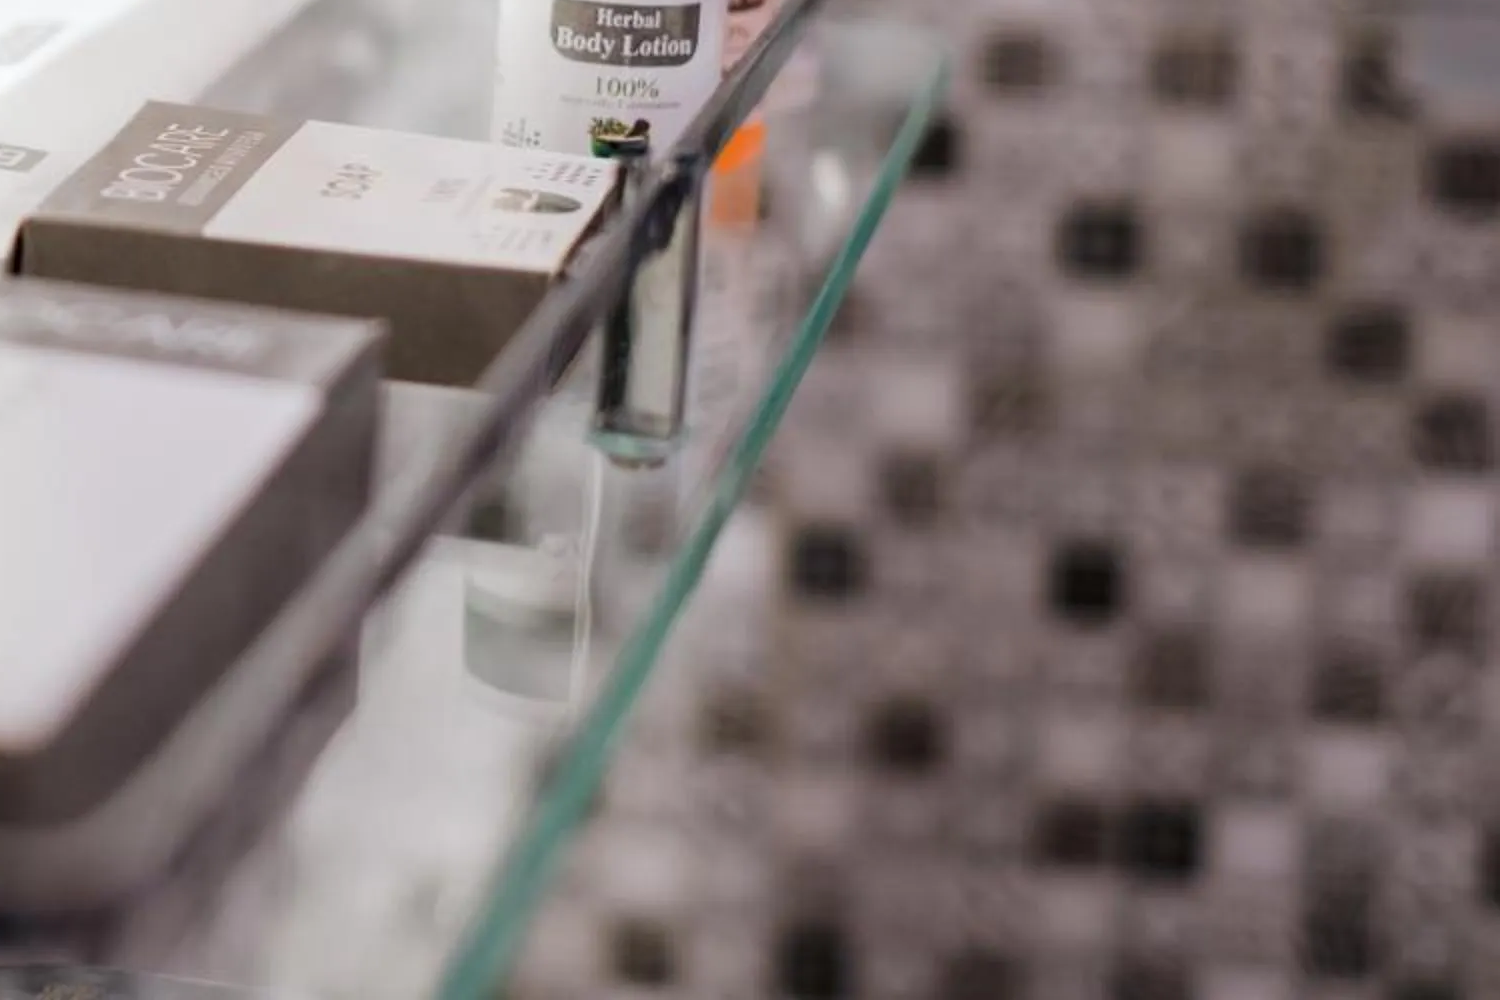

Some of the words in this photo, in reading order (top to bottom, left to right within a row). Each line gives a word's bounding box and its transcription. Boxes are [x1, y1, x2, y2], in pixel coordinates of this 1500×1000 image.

[596, 7, 662, 30] Herbal
[556, 26, 616, 58] Body
[620, 33, 693, 58] Lotion
[595, 75, 660, 99] 100%
[99, 123, 230, 202] BIOCARE
[319, 163, 382, 200] SOAP
